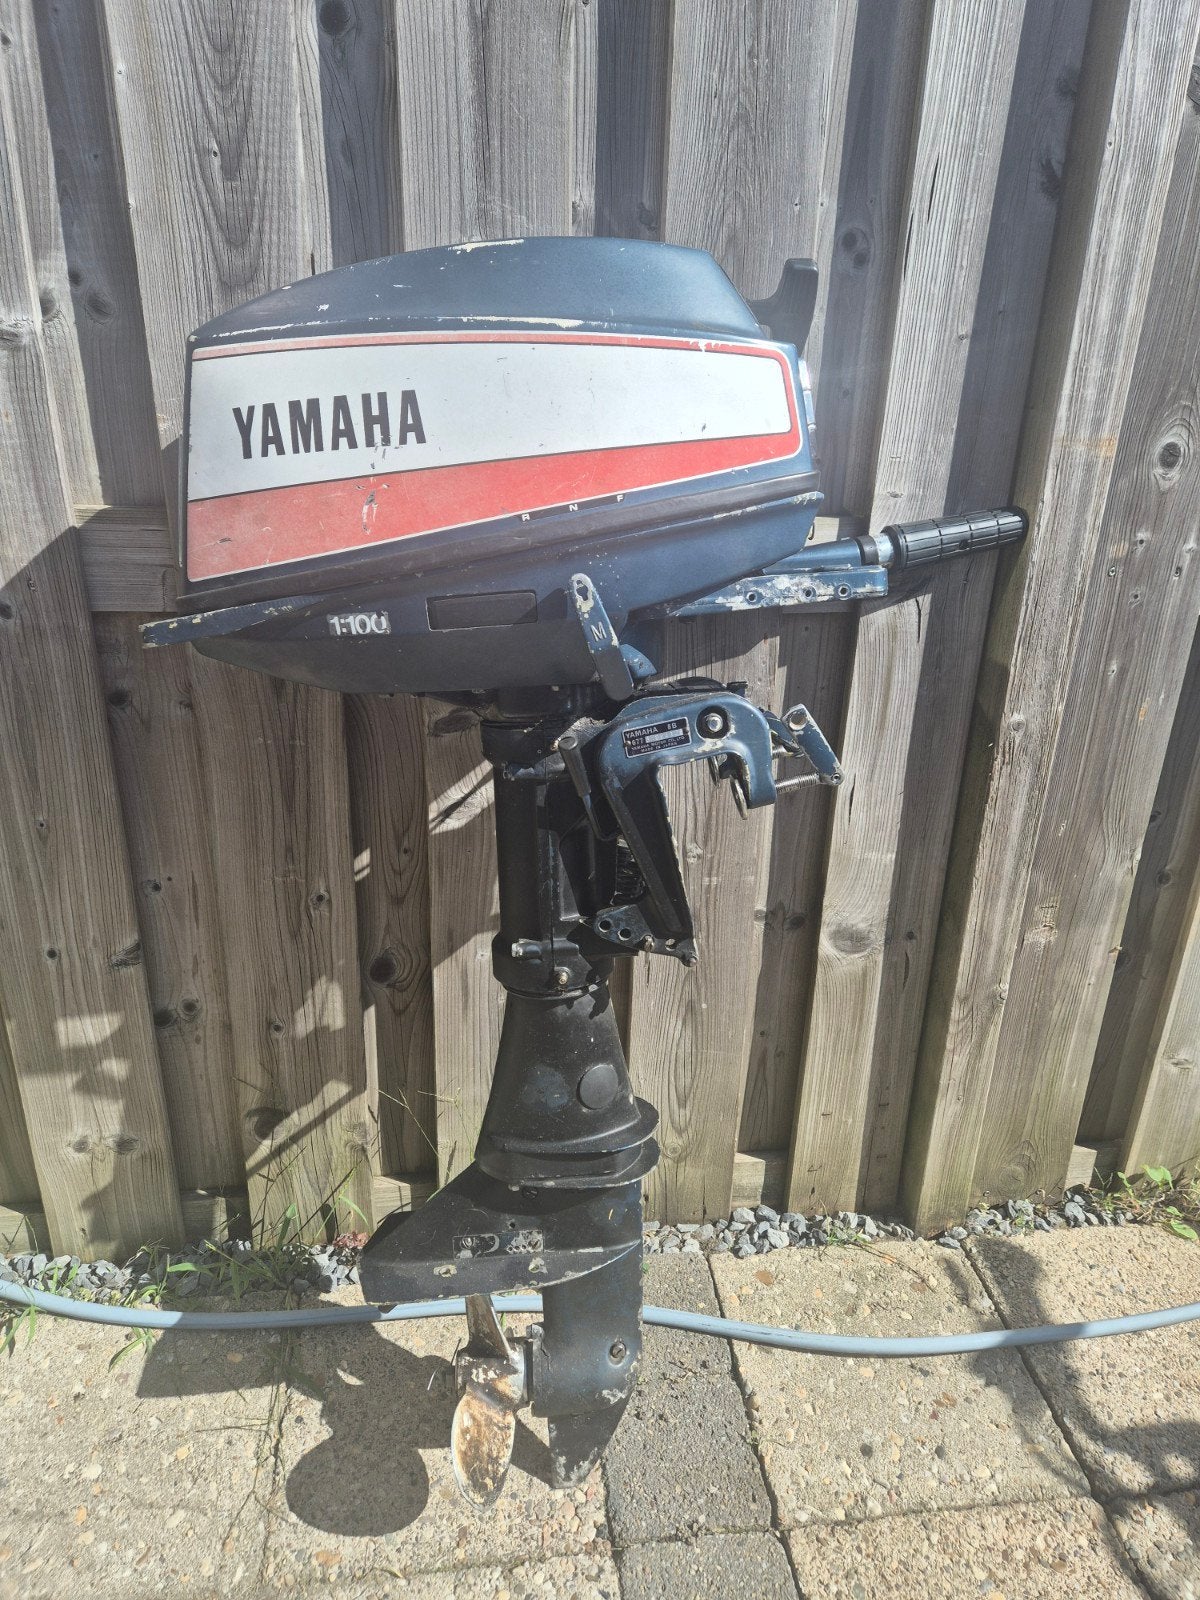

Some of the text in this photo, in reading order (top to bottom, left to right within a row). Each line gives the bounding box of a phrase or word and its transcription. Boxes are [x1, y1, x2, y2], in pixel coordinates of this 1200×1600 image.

[232, 389, 426, 460] YAMAHA
[521, 494, 624, 522] R N F
[329, 614, 387, 636] 1:100
[590, 621, 607, 642] M
[625, 726, 659, 739] YAMAHA
